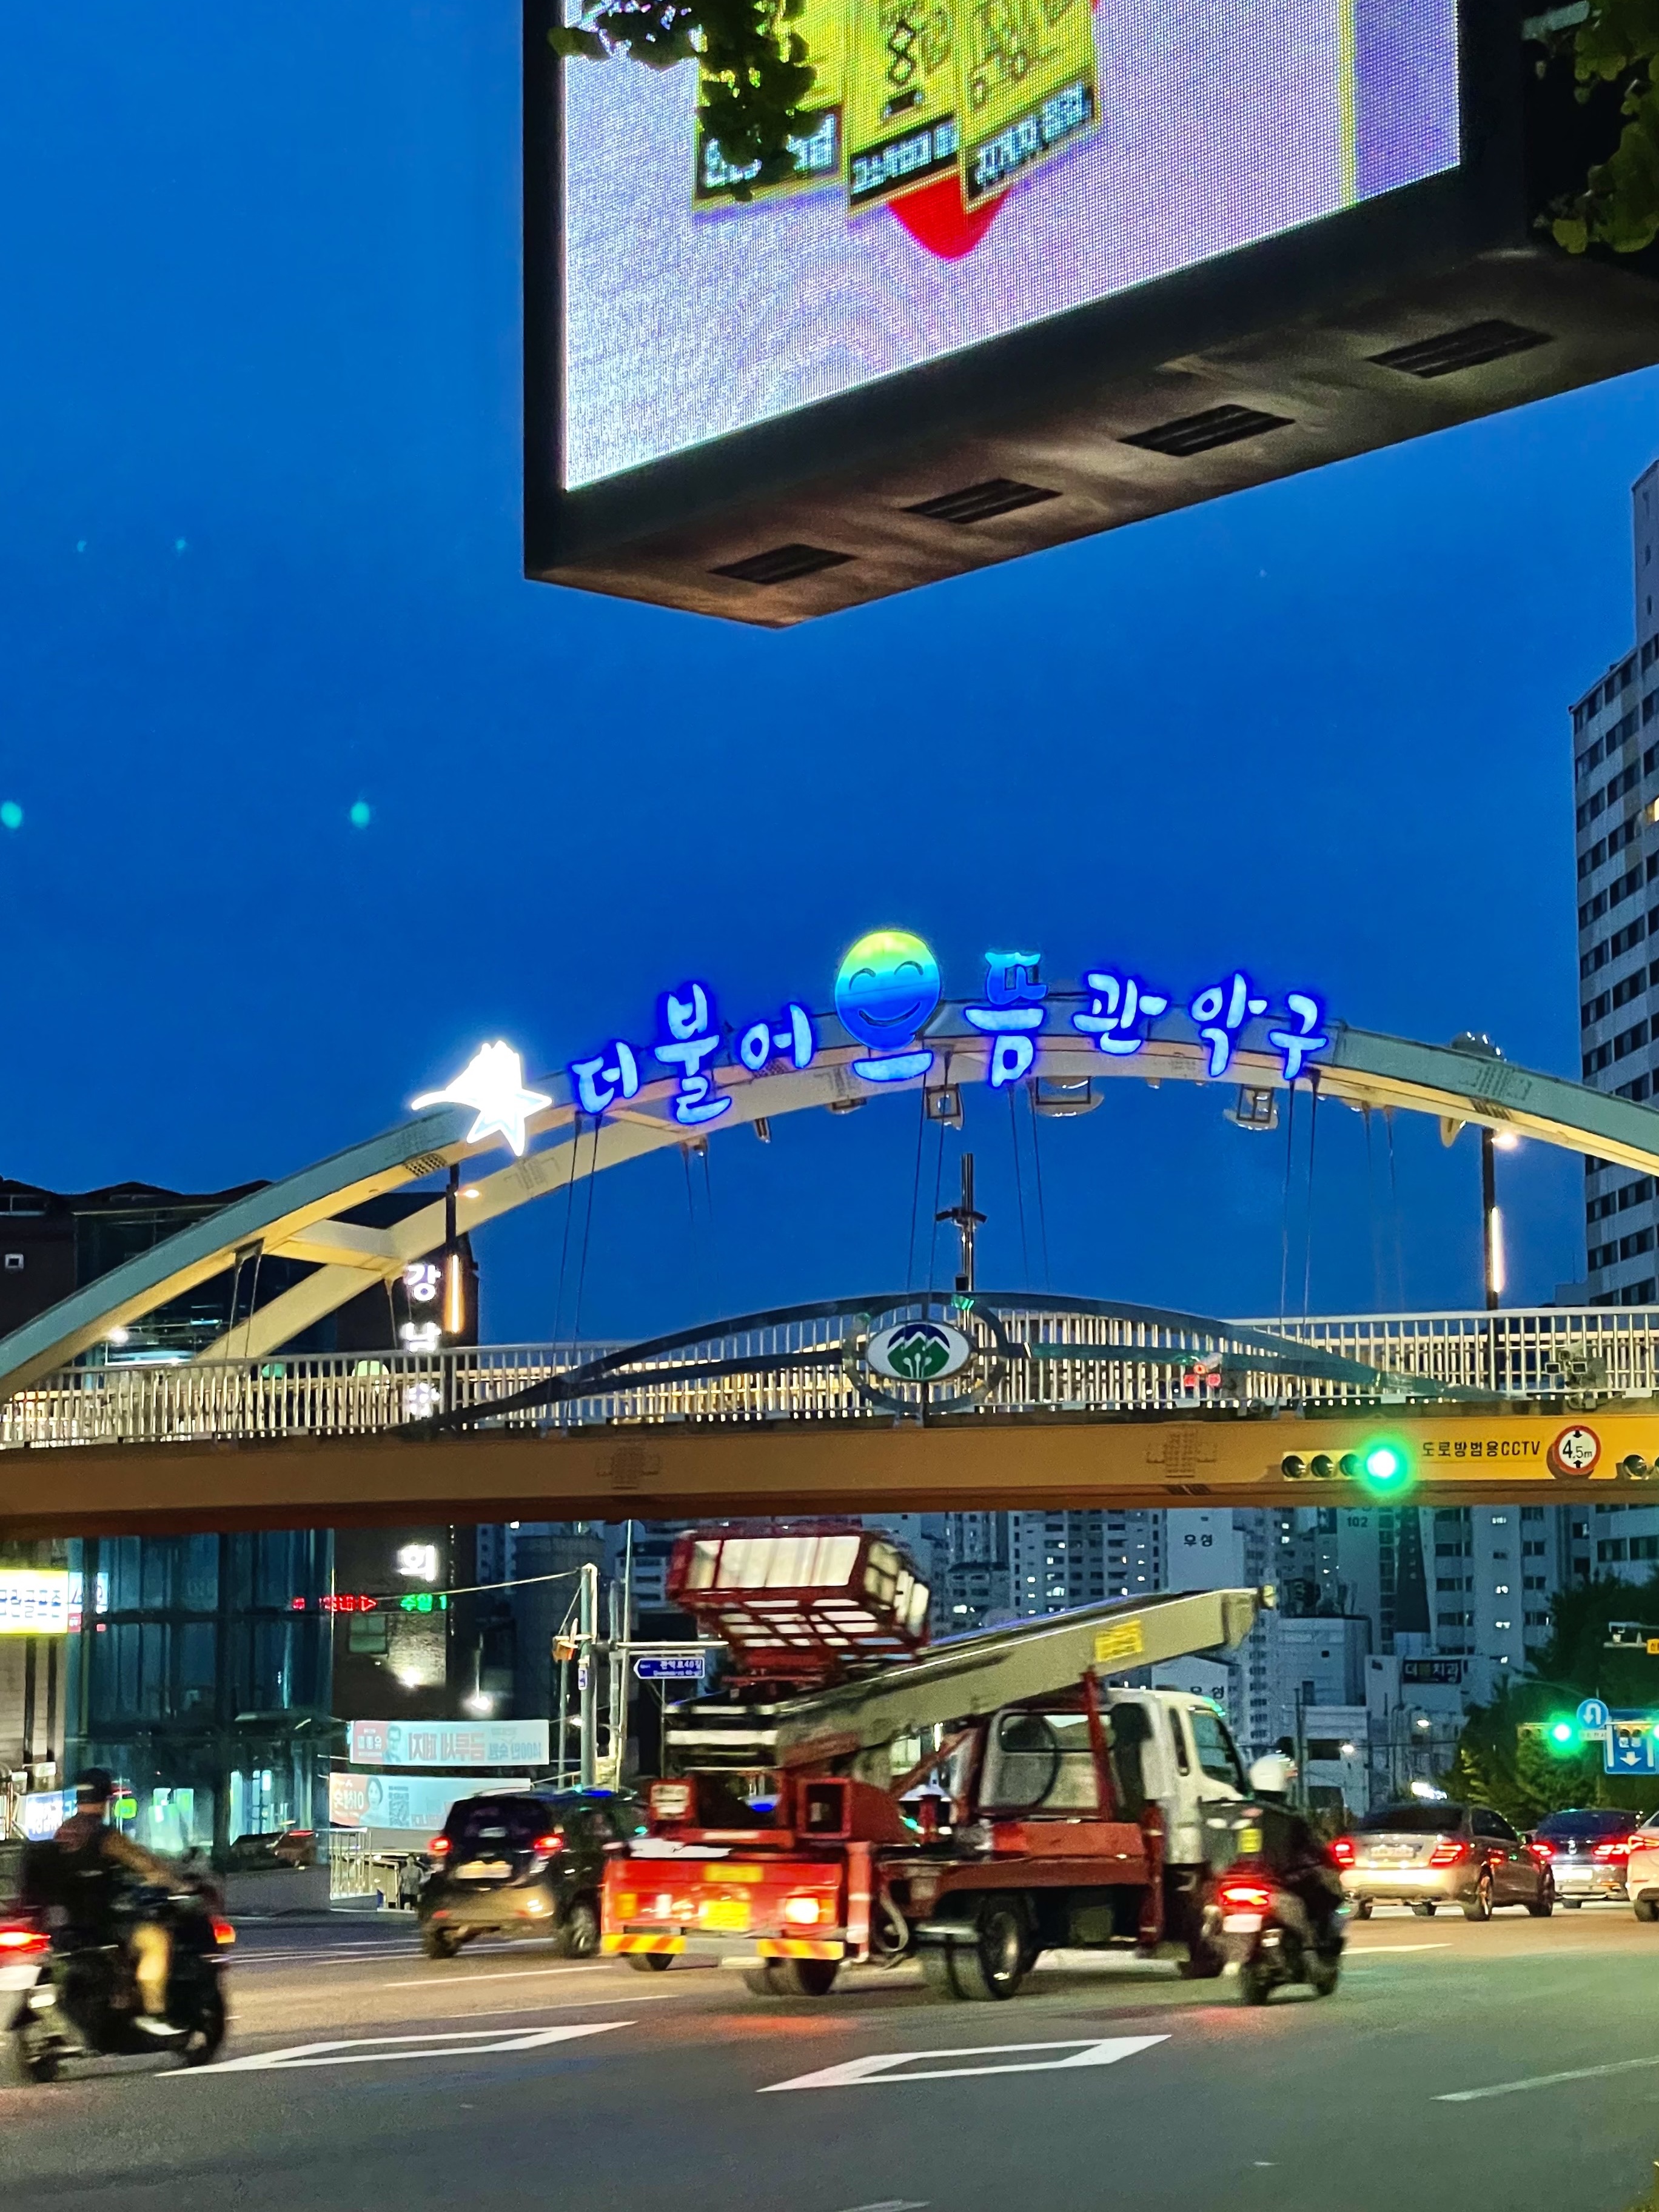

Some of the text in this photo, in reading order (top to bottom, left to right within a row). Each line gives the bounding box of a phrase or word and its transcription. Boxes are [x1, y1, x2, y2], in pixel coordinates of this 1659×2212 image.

[572, 983, 813, 1124] 더불어
[1073, 972, 1327, 1080] 관악구
[1423, 1440, 1540, 1457] 도로방범용CCTV
[1562, 1440, 1593, 1459] 4.5m
[1347, 1516, 1368, 1528] 102
